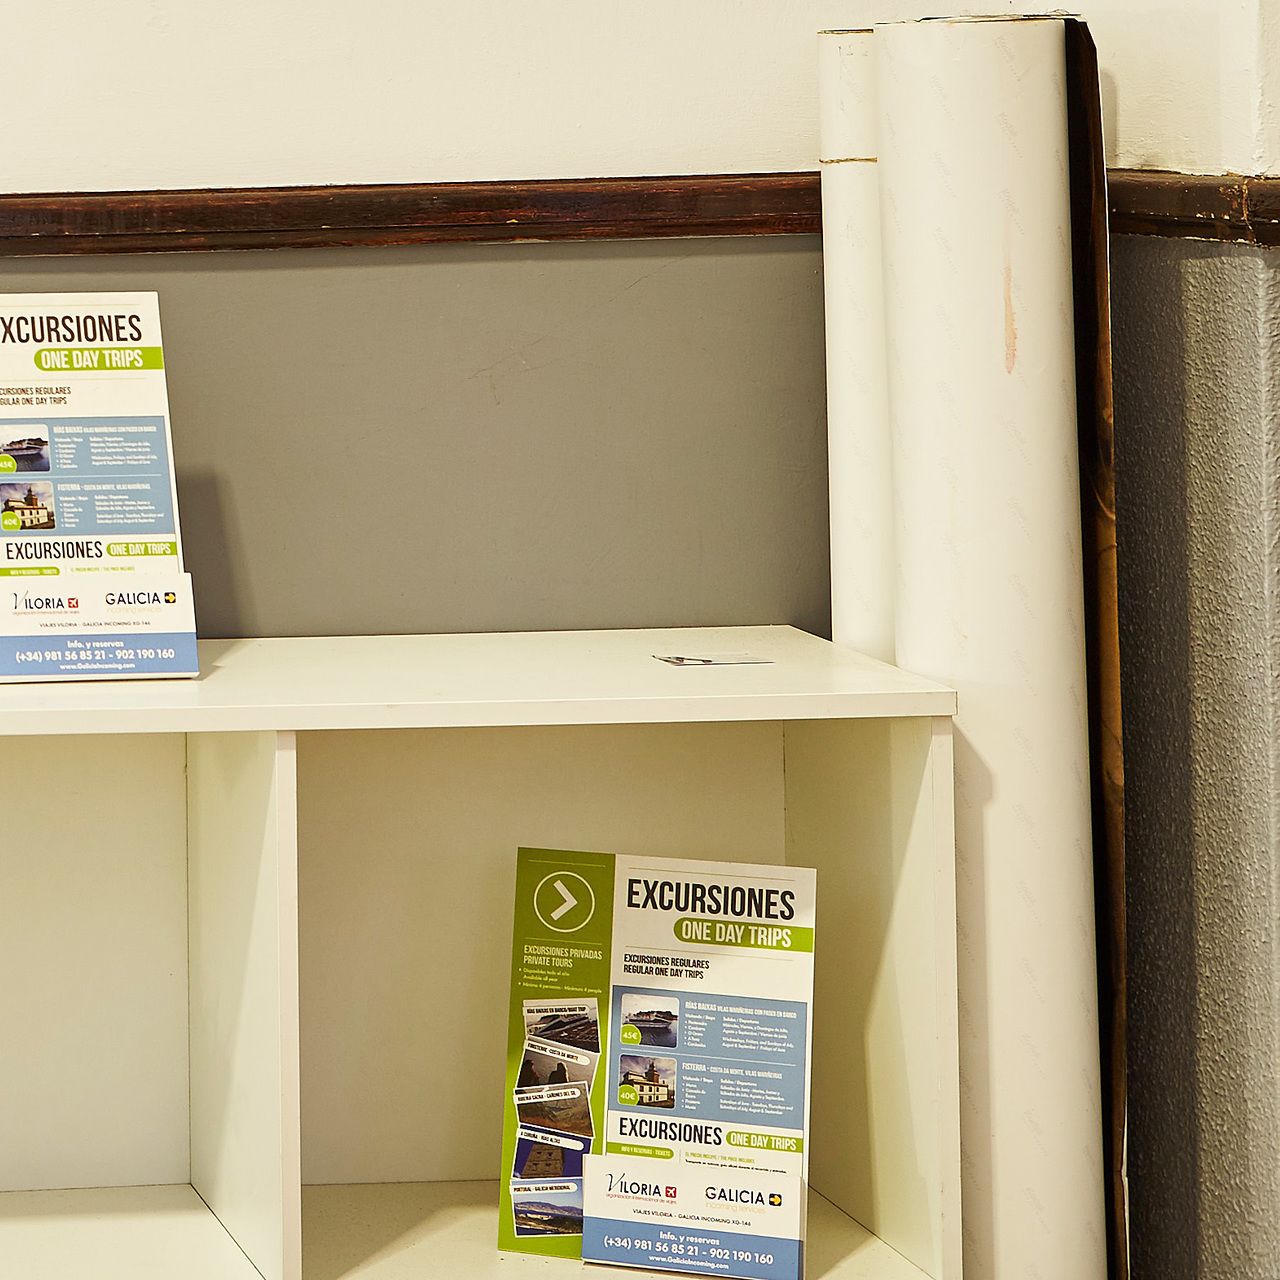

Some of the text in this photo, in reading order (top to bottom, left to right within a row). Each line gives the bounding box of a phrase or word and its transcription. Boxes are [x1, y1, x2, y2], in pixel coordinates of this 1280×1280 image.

[41, 348, 143, 370] ONE DAY TRIPS
[35, 386, 71, 395] REGULARES
[22, 397, 34, 405] ONE
[35, 397, 48, 405] DAY
[50, 397, 67, 405] TRIPS
[6, 541, 103, 560] EXCURSIONES
[110, 543, 171, 556] ONE DAY TRIPS
[13, 590, 64, 610] VILORIA
[106, 592, 160, 605] GALICIA
[67, 640, 84, 648] Info.
[16, 651, 43, 664] (+34)
[44, 651, 62, 661] 981
[65, 651, 78, 660] 56
[80, 650, 93, 660] 85
[94, 650, 105, 660] 21
[116, 649, 135, 659] 902
[137, 649, 155, 659] 190
[156, 649, 175, 658] 160
[627, 878, 795, 920] EXCURSIONES
[681, 920, 792, 948] ONE DAY TRIPS
[524, 945, 602, 960] EXCURSIONES PRIVADAS
[523, 956, 573, 968] PRIVATE TOURS
[624, 954, 710, 969] EXCURSIONES REGULARES
[623, 965, 704, 979] REGULAR ONE DAY TRIPS
[623, 1031, 638, 1040] 45€
[682, 1063, 707, 1072] FISTERRA
[620, 1092, 635, 1100] 40€
[620, 1117, 722, 1146] EXCURSIONES
[730, 1134, 796, 1150] ONE DAY TRIPS
[606, 1172, 661, 1196] VILORIA
[706, 1186, 765, 1205] GALICIA
[652, 1210, 673, 1218] VILORIA
[678, 1213, 700, 1221] GALICIA
[701, 1216, 730, 1224] INCOMING
[659, 1232, 678, 1241] Info.
[686, 1236, 719, 1246] reservas
[604, 1235, 632, 1249] (+34)
[634, 1240, 652, 1251] 981
[655, 1242, 669, 1253] 56
[671, 1244, 684, 1255] 85
[687, 1246, 699, 1256] 21
[710, 1248, 729, 1259] 902
[733, 1250, 751, 1262] 190
[754, 1253, 773, 1264] 160
